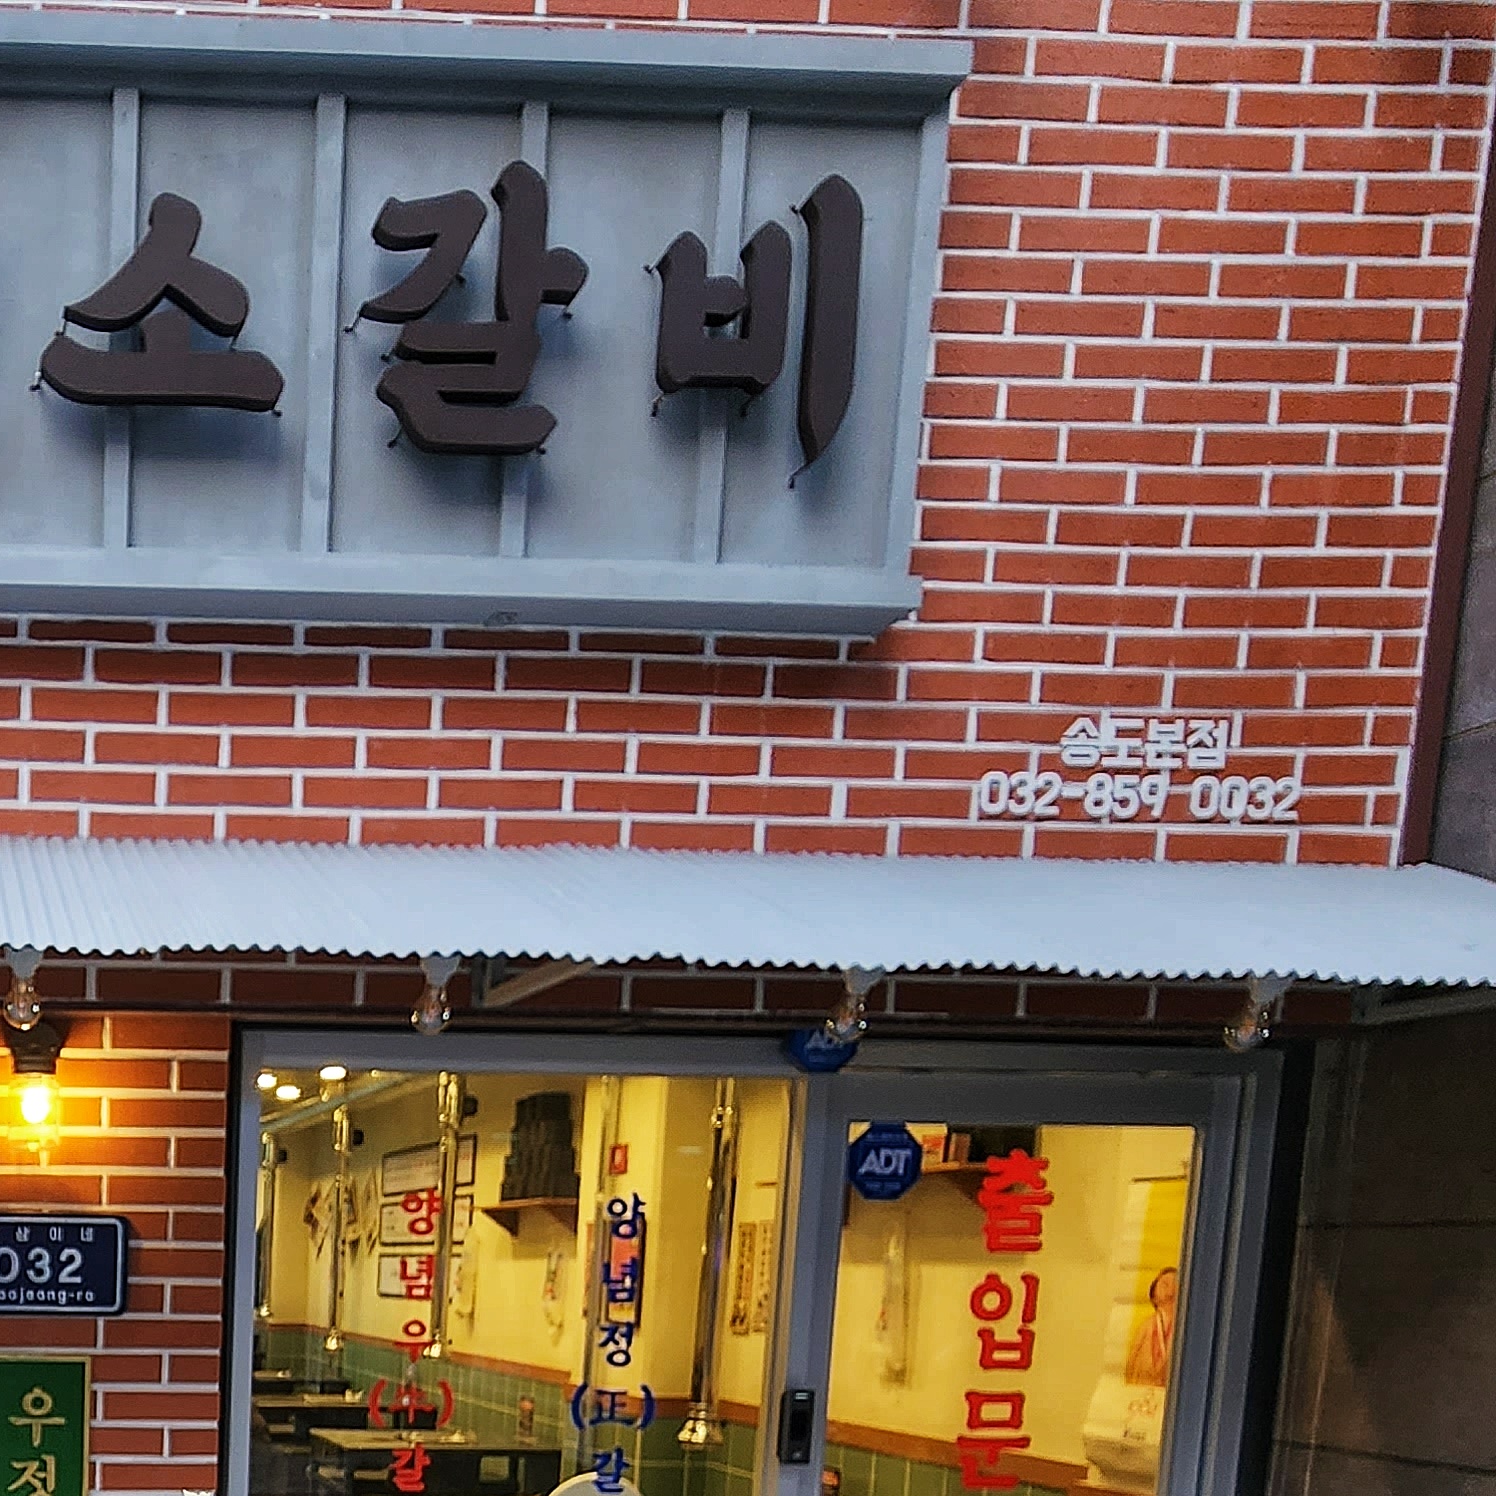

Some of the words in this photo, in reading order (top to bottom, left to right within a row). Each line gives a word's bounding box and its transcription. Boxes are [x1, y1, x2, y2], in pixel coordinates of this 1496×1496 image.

[1060, 717, 1229, 770] 송도본점
[980, 770, 1170, 820] 032-859
[1188, 774, 1302, 822] 0032
[858, 1148, 913, 1176] ADT
[956, 1148, 1054, 1490] 출입문
